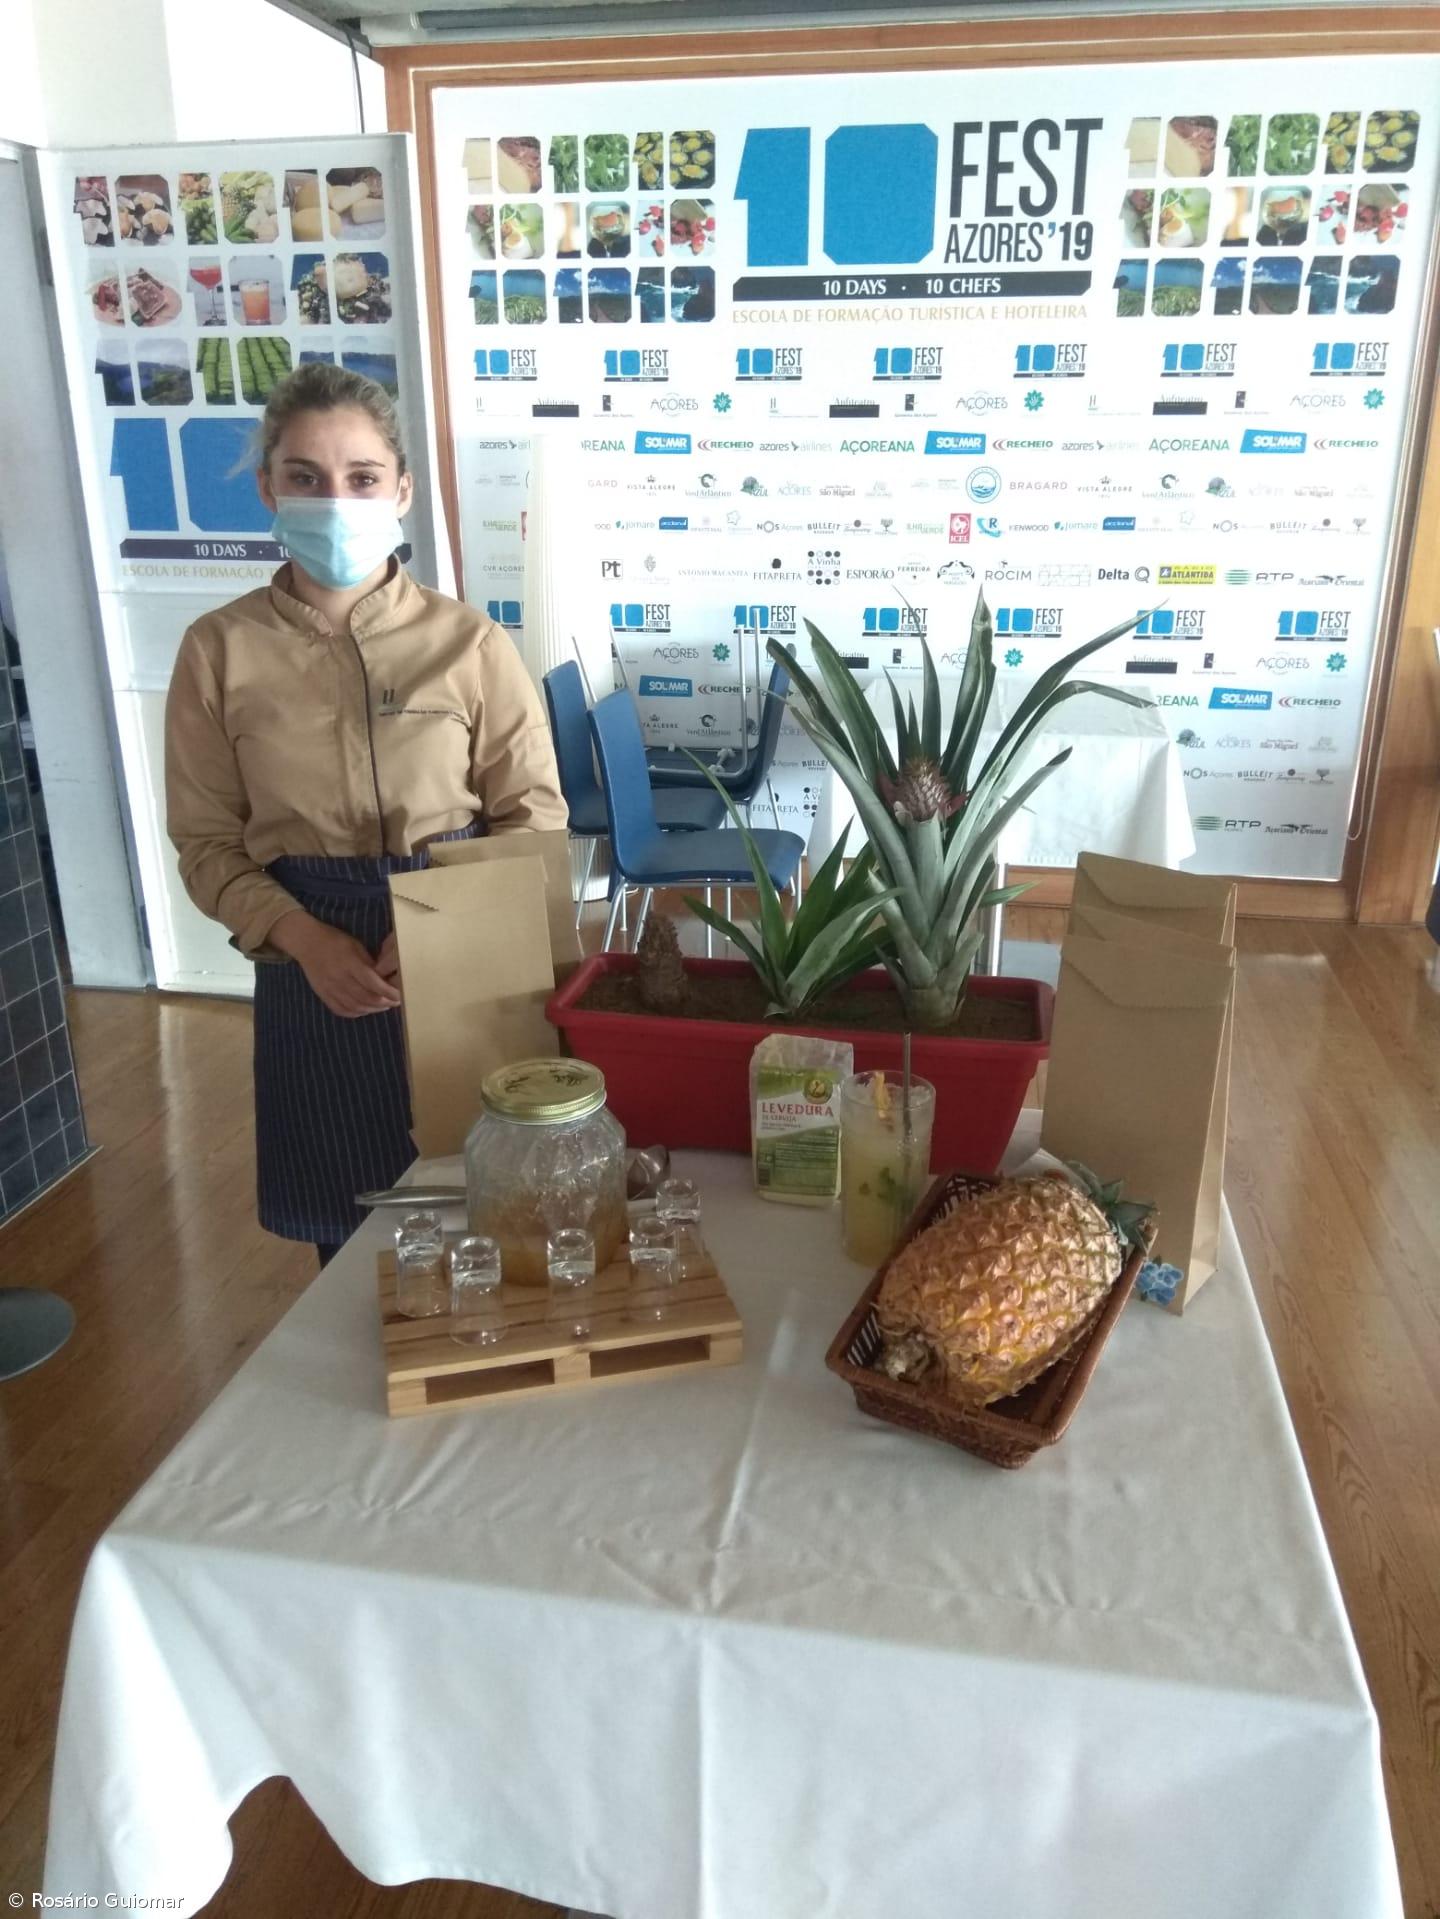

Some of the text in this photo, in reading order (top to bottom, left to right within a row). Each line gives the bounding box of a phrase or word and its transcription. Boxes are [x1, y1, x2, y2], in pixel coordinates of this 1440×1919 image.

[733, 117, 1103, 266] 10 FEST
[823, 278, 1001, 296] 10 DAYS 10 CHEFS
[733, 303, 1087, 325] ESCOLA DE FORMAÇÃO TURÍSTICA E HOTELEIRA
[511, 349, 537, 367] FEST
[642, 349, 669, 367] FEST
[775, 348, 802, 366] FEST
[914, 347, 943, 366] FEST
[1057, 344, 1087, 363] FEST
[1206, 343, 1237, 362] FEST
[1357, 342, 1389, 362] FEST
[710, 441, 754, 449] RECHEIO
[759, 441, 789, 452] azores
[840, 440, 915, 455] AÇOREANA
[1006, 440, 1053, 448] RECHEIO
[1061, 441, 1094, 451] azores
[1149, 438, 1230, 454] AÇOREANA
[1329, 440, 1378, 448] RECHEIO
[1009, 481, 1068, 490] BRAGARD
[1009, 524, 1049, 532] KENWOOD
[193, 544, 209, 557] 10
[213, 544, 247, 557] DAYS
[816, 557, 841, 566] Vinha
[122, 564, 170, 577] ESCOLA
[173, 565, 190, 577] DE
[192, 564, 264, 580] FORMAÇÃO
[753, 571, 802, 581] FITAPRETA
[846, 568, 895, 580] ESPORÃO
[984, 570, 1032, 581] ROCIM
[1098, 568, 1130, 580] Delta
[646, 603, 671, 620] FEST
[770, 605, 797, 621] FEST
[901, 607, 928, 624] FEST
[1035, 608, 1064, 624] FEST
[1175, 610, 1206, 627] FEST
[1320, 610, 1351, 628] FEST
[652, 646, 700, 662] AÇORES
[752, 804, 799, 813] FITARETA
[1224, 819, 1261, 828] RTP
[762, 1101, 834, 1118] LEVEDURA
